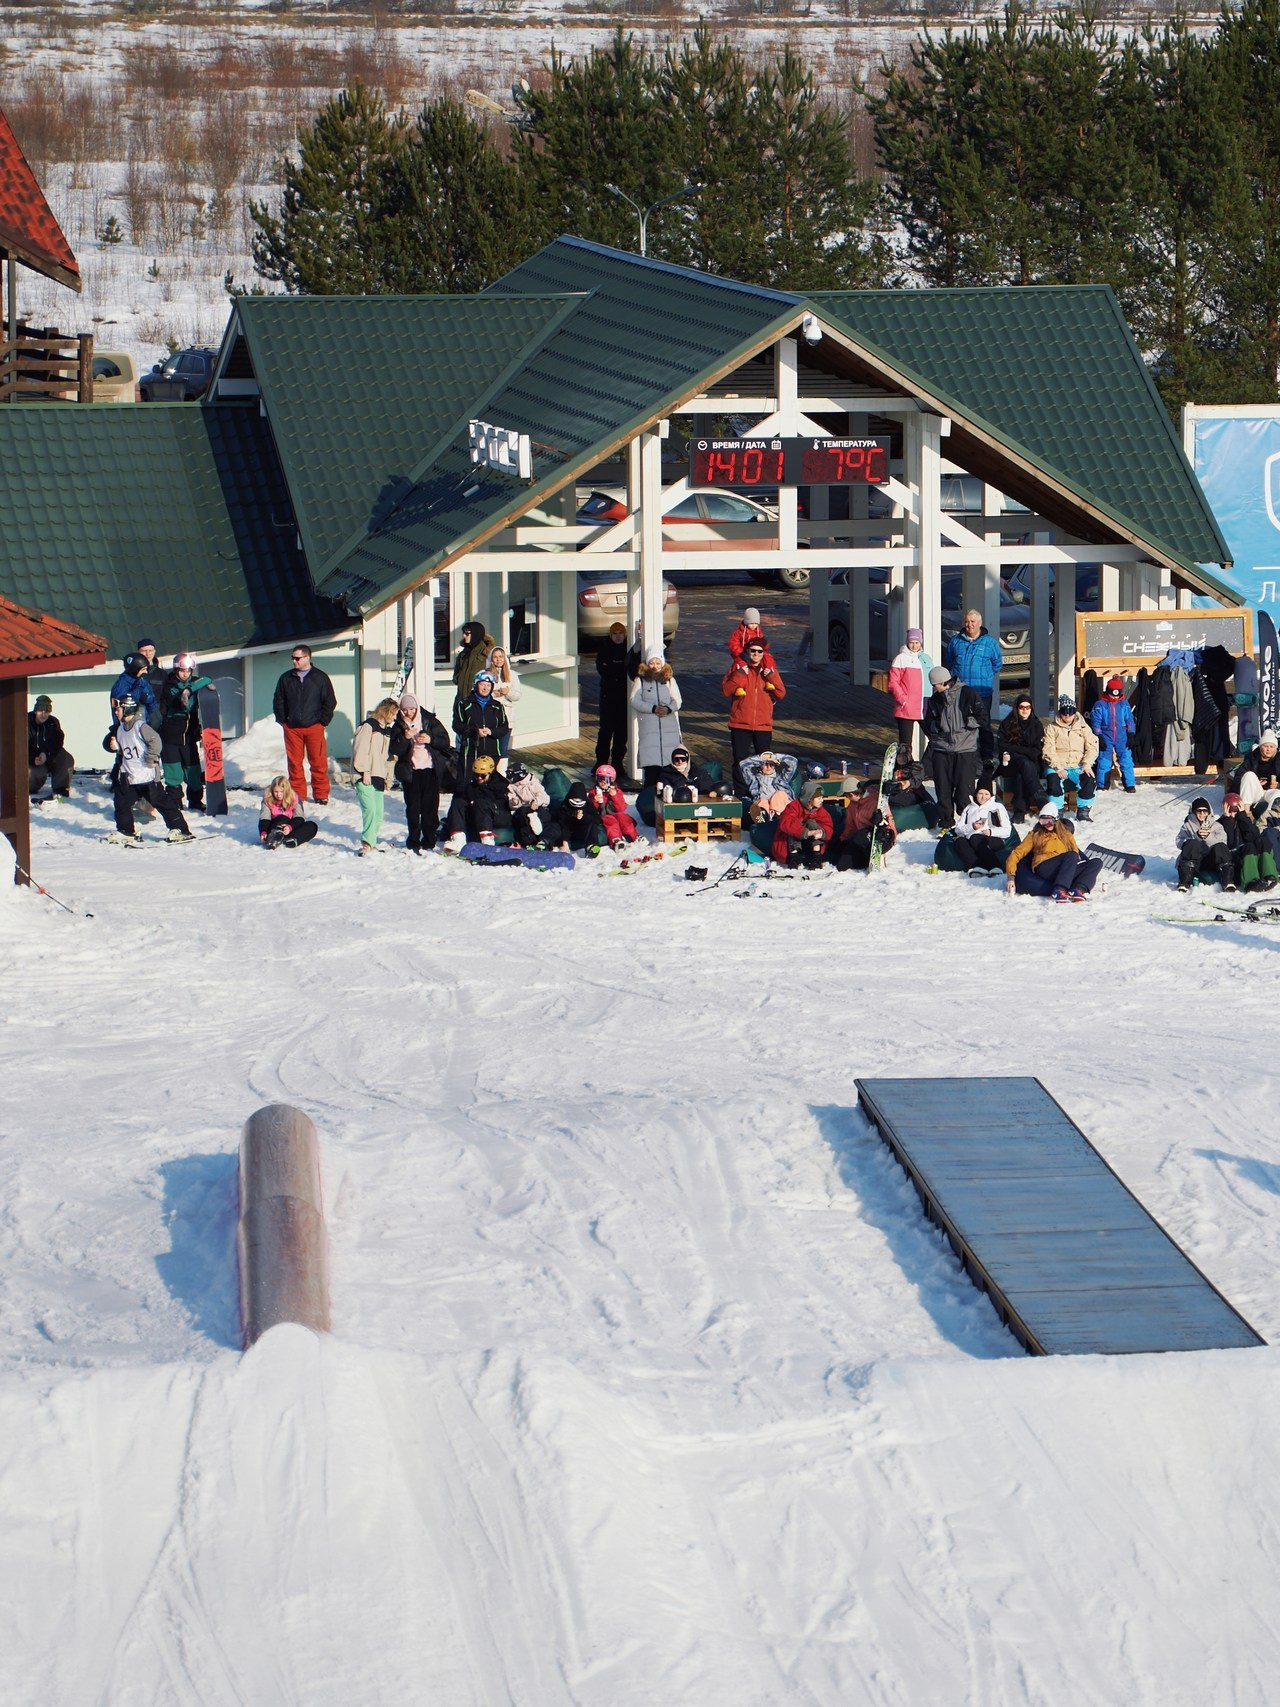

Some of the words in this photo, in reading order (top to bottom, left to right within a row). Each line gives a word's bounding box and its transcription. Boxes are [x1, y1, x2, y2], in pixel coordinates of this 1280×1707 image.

[712, 441, 740, 449] ВРЕМЯ
[745, 441, 767, 450] ДАТА
[822, 440, 877, 448] ТЕМПЕРАТУРА
[123, 745, 140, 760] 31
